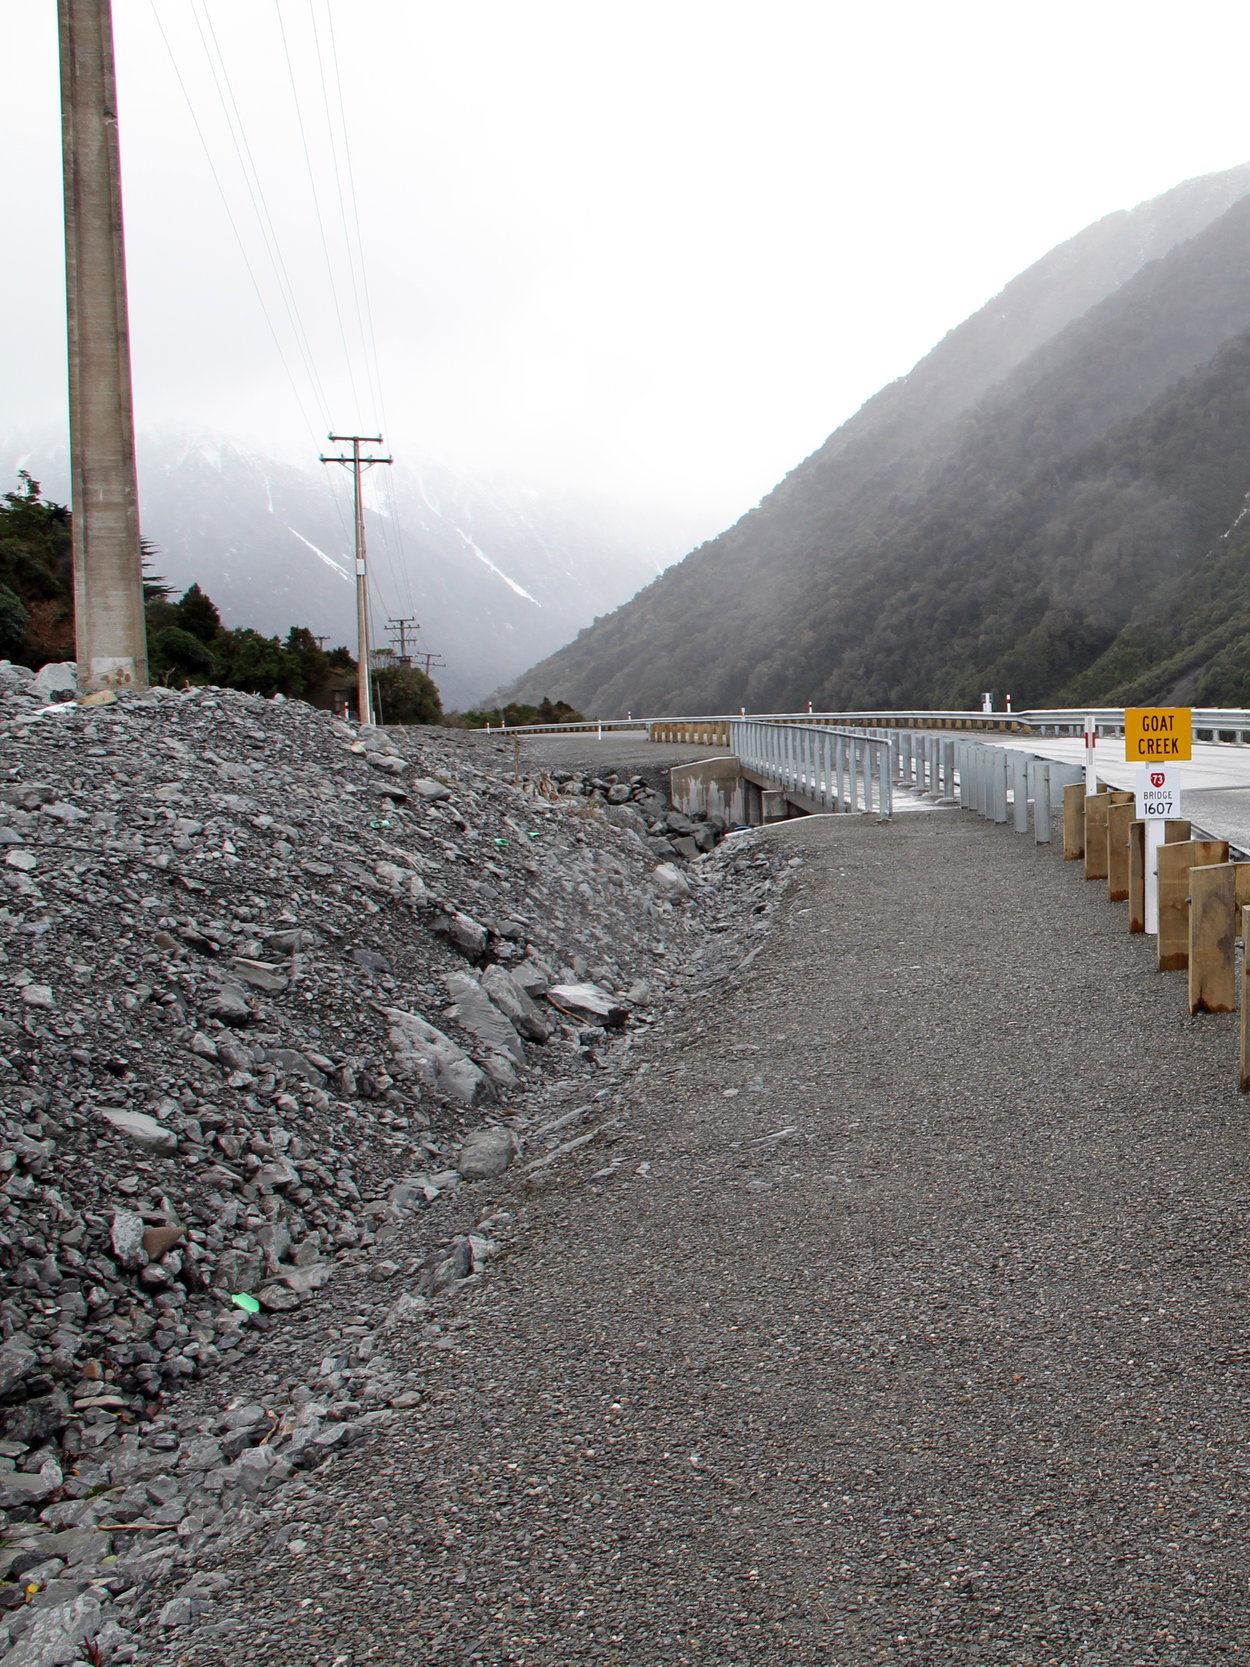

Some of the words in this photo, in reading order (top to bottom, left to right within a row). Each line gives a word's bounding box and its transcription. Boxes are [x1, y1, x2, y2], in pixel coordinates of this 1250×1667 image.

[1142, 715, 1174, 732] GOAT
[1138, 738, 1179, 754] CREEK
[1152, 775, 1163, 784] 73
[1143, 791, 1172, 800] BRIDGE
[1144, 802, 1173, 815] 1607
